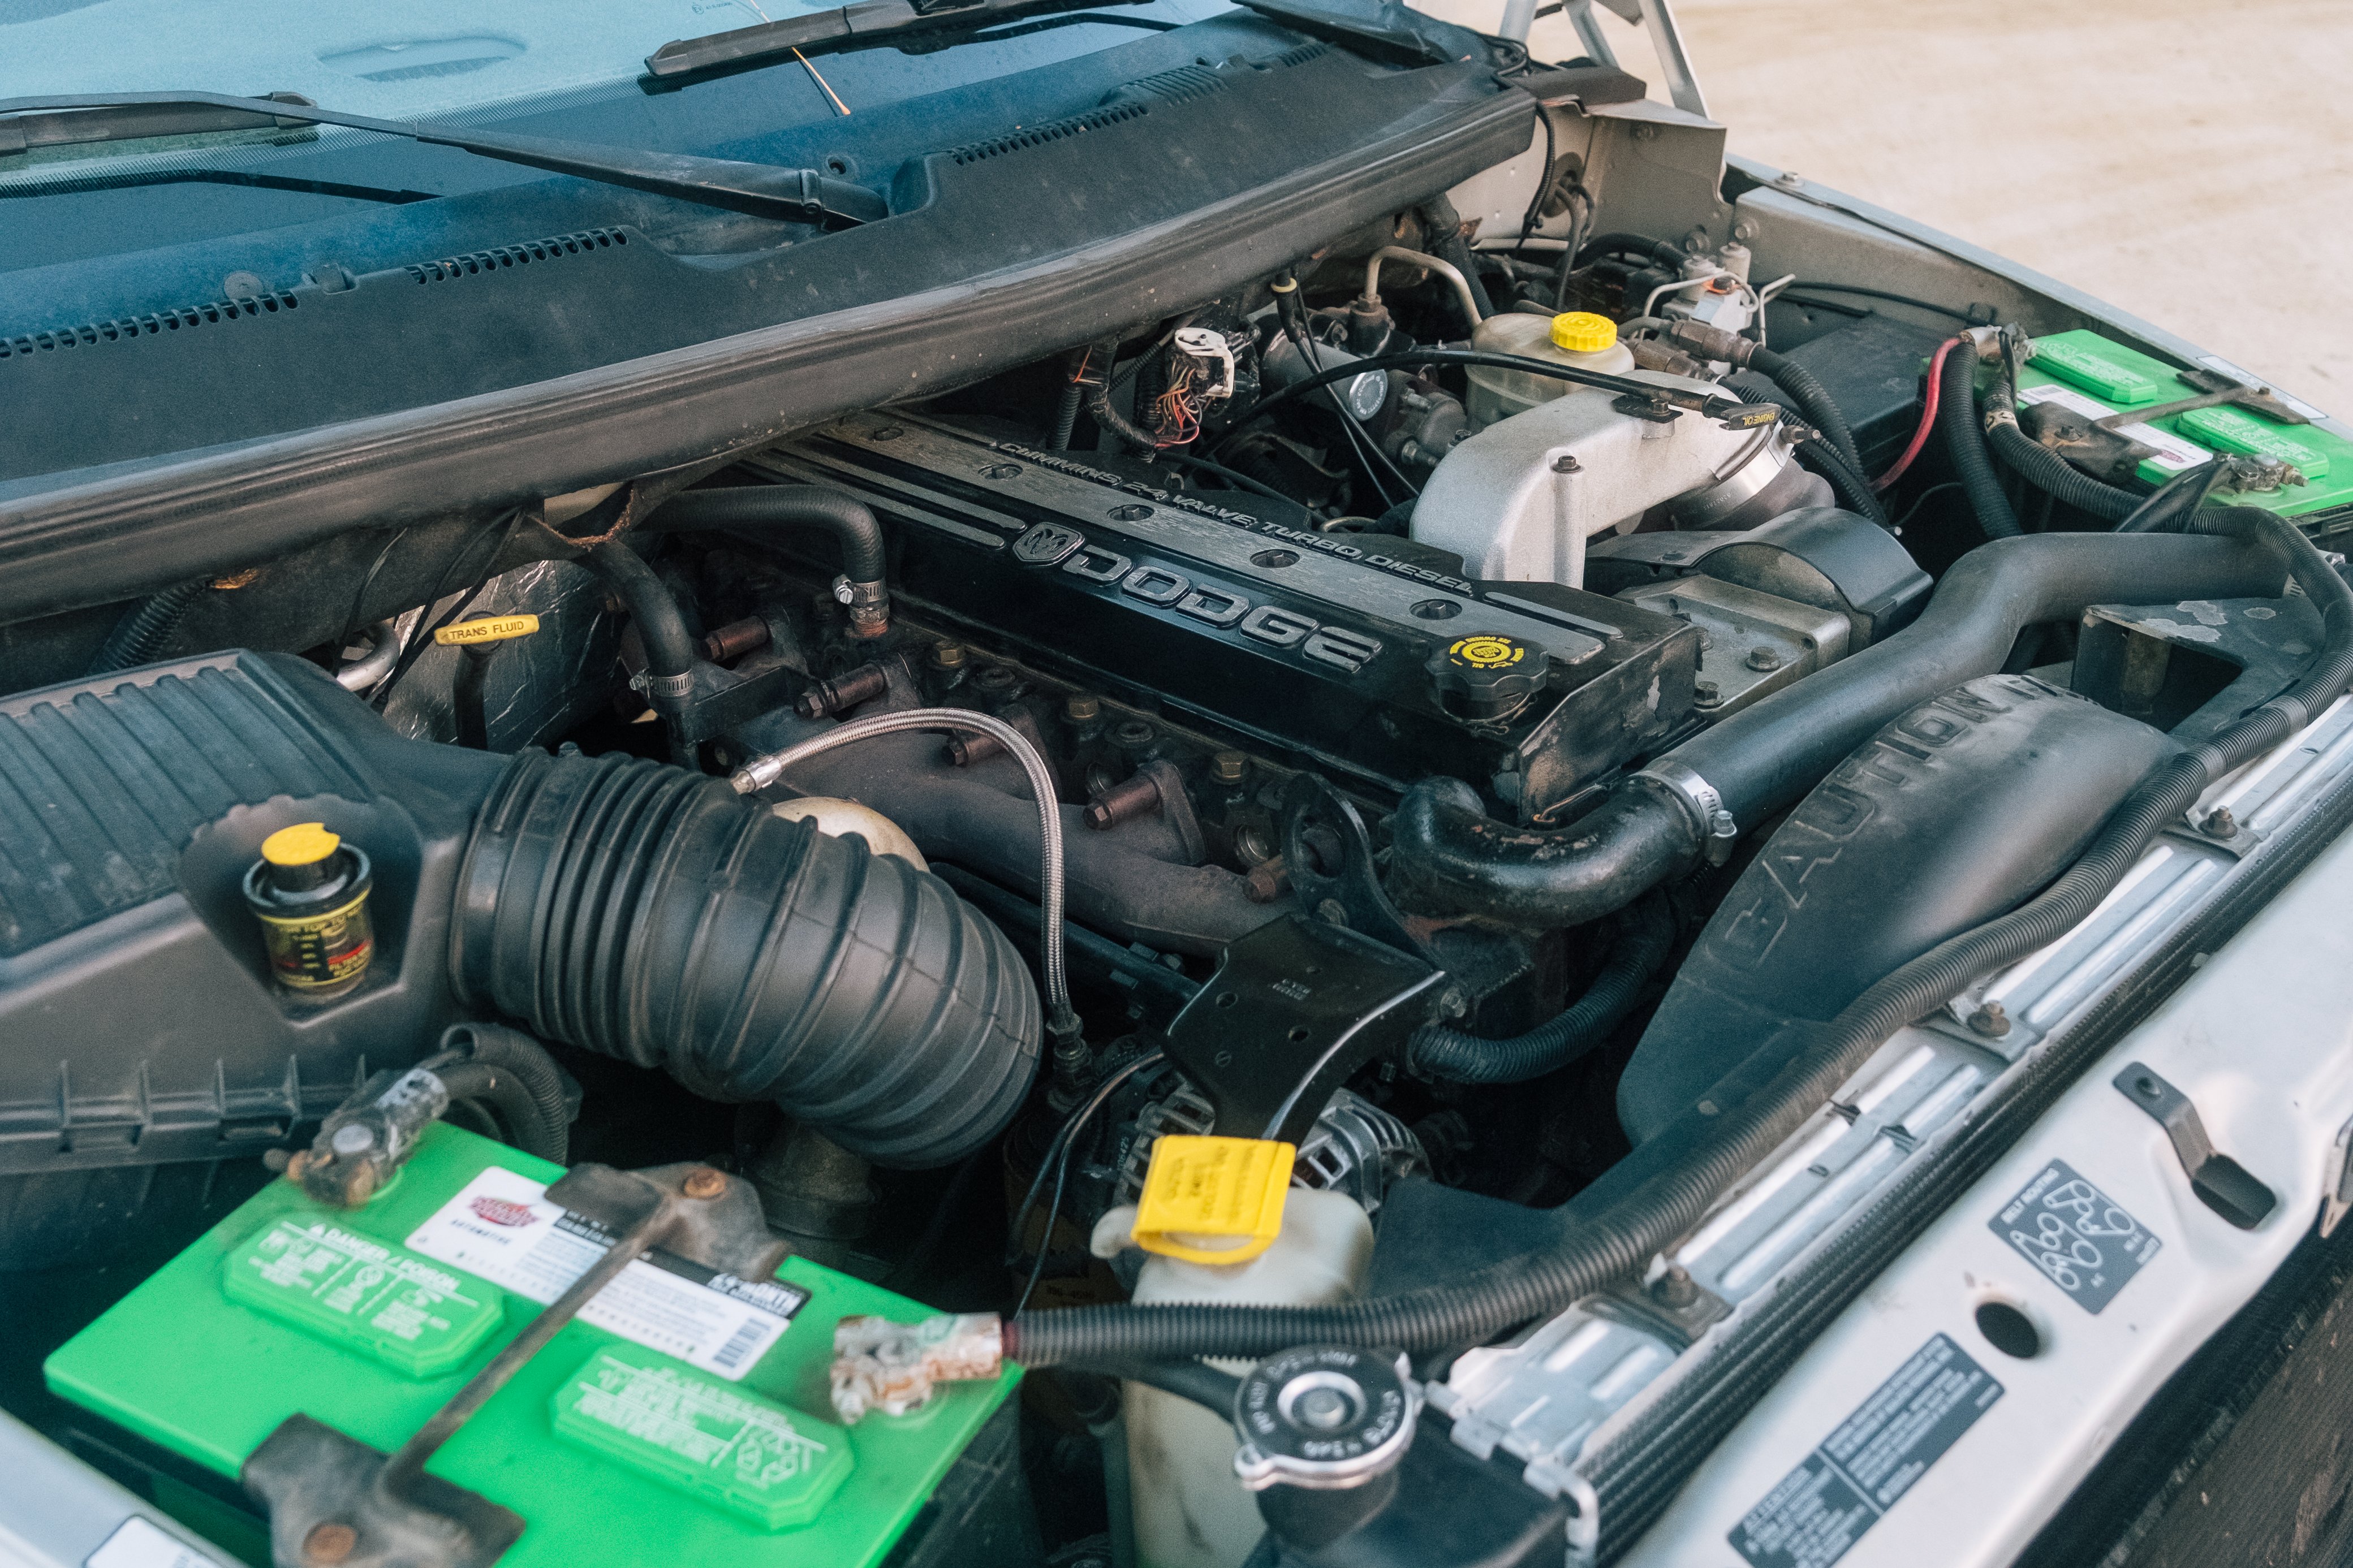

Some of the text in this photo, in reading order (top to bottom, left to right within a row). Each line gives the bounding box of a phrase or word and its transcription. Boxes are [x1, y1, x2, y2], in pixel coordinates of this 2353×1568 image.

[1743, 412, 1775, 425] ENGINE OIL
[999, 443, 1473, 596] CUMMINS 24 VALVE TURBO DIESEL
[449, 621, 524, 640] TRANS FLUID
[1063, 545, 1384, 673] DODGE
[1703, 683, 2012, 965] CAUTION
